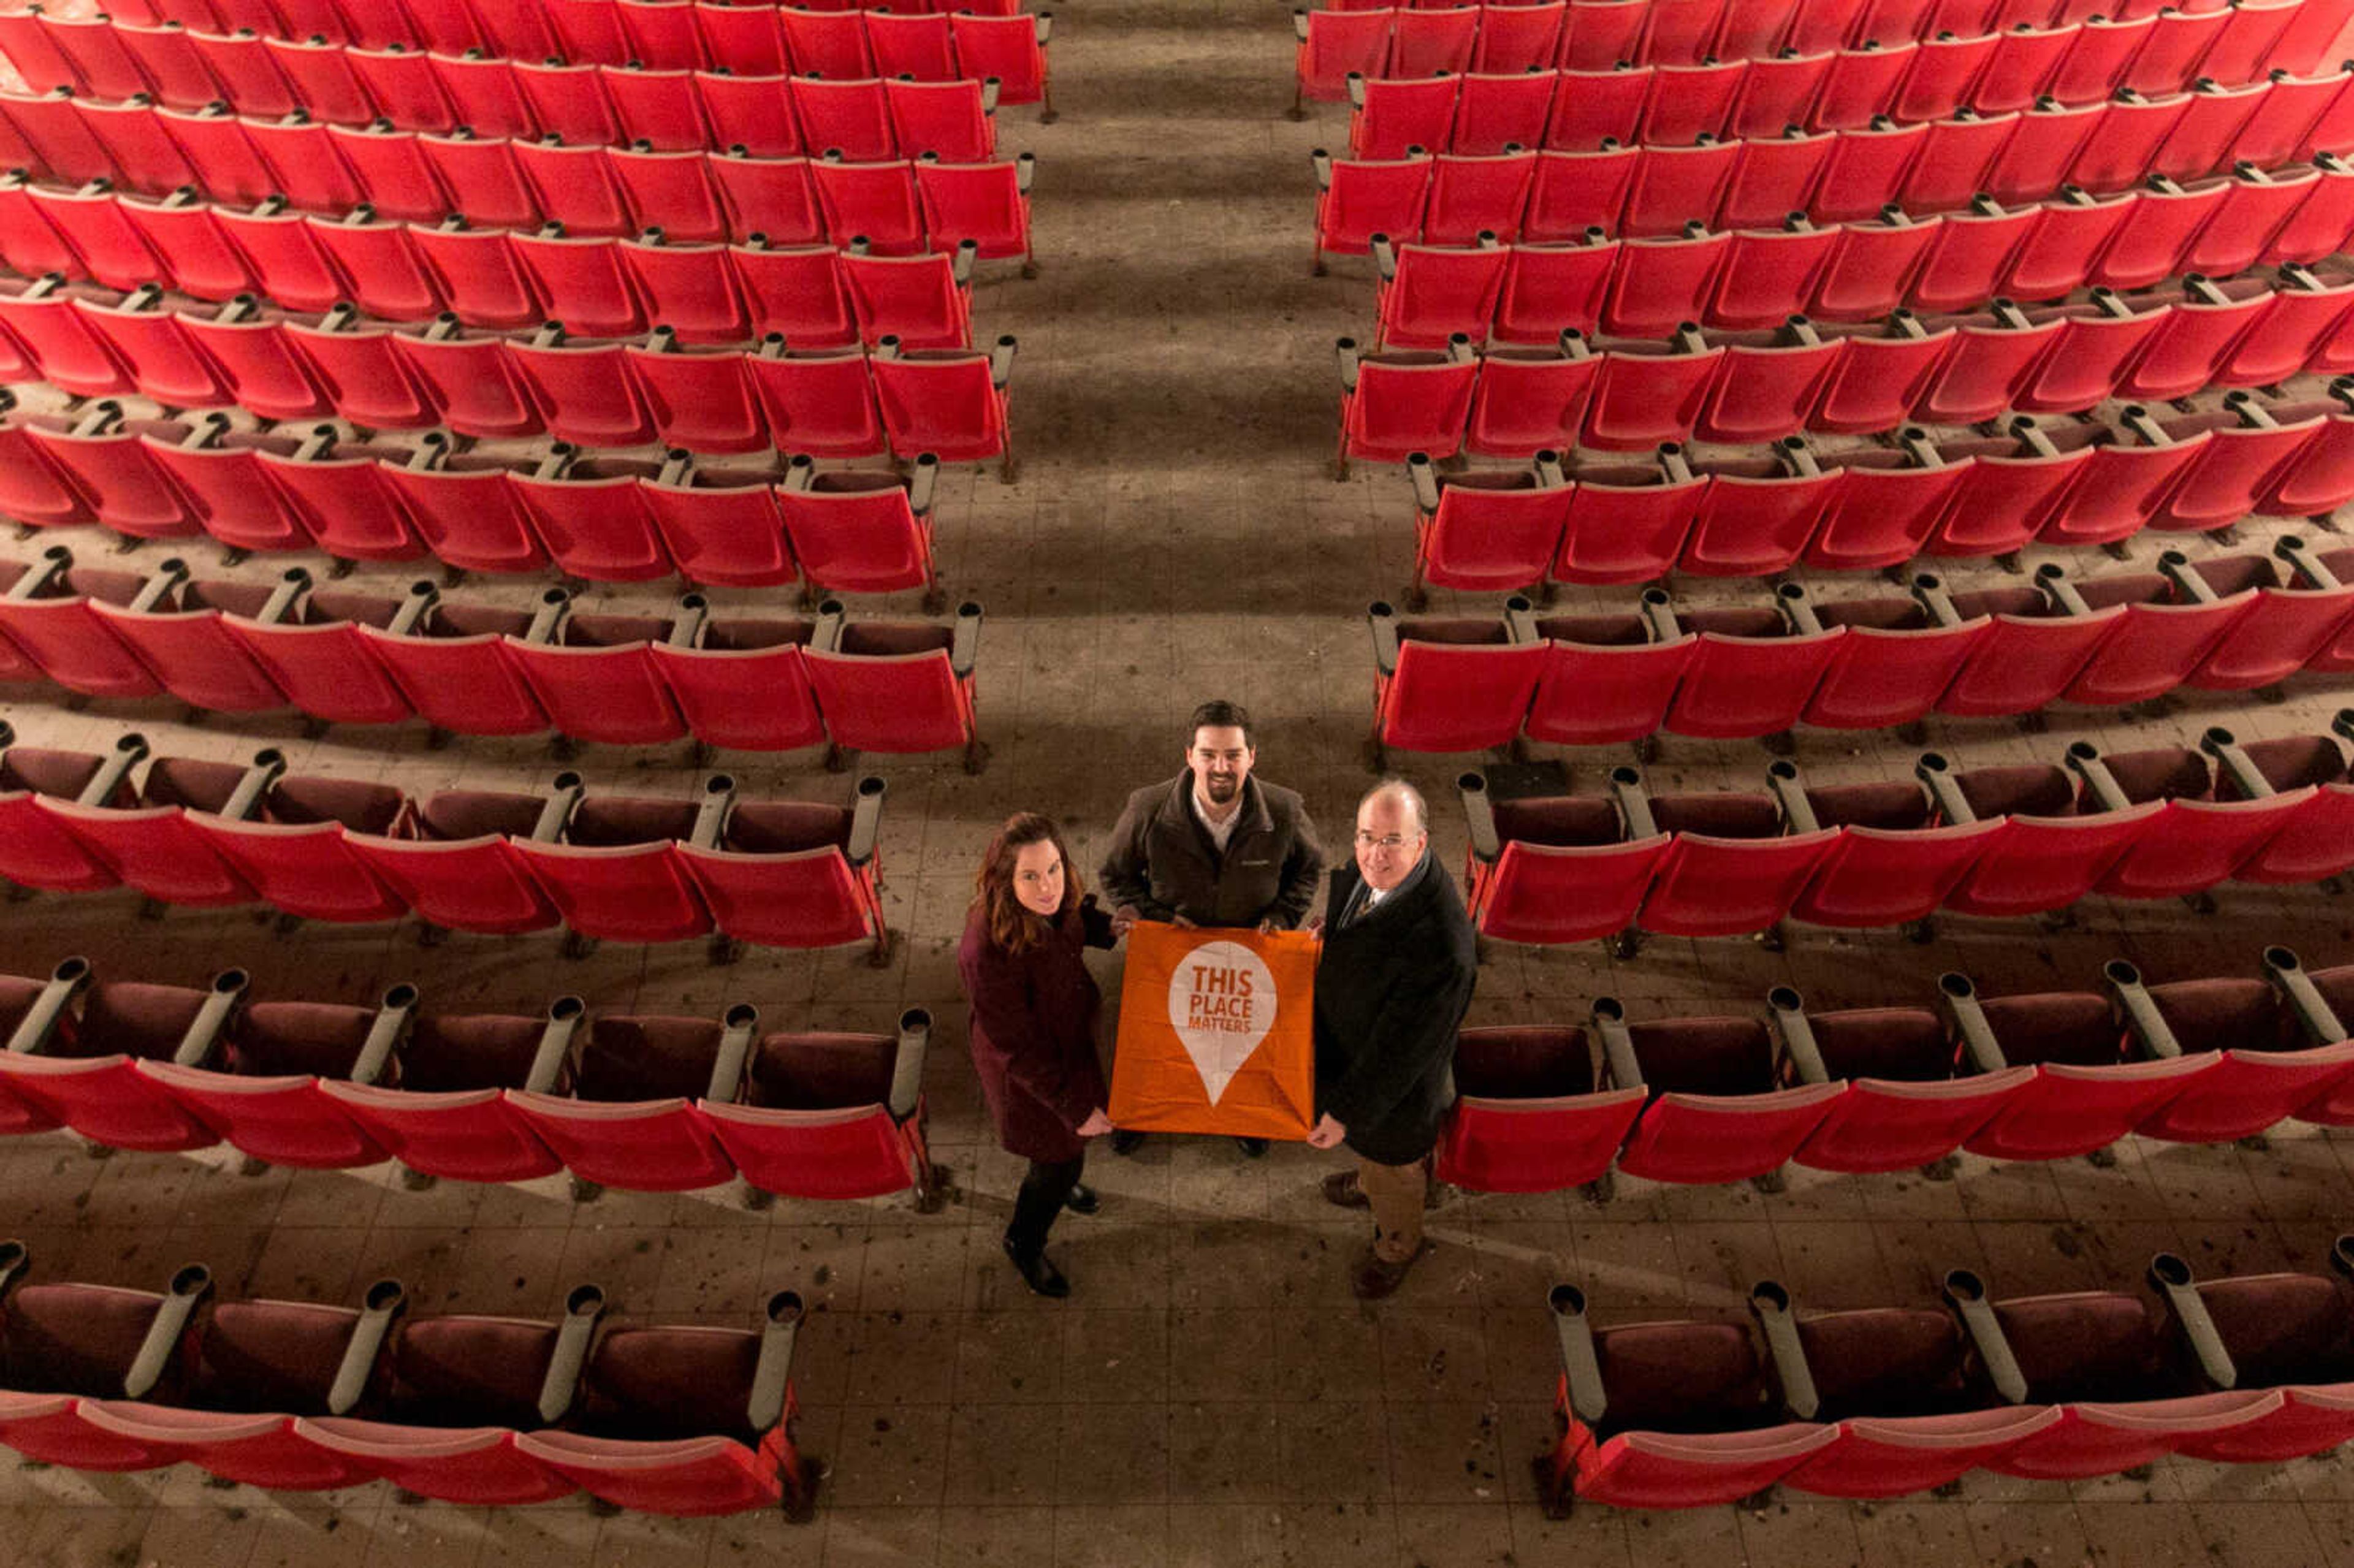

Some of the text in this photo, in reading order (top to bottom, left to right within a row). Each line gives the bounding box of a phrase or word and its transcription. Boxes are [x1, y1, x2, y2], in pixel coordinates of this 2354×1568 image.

[1193, 966, 1253, 997] THIS
[1190, 995, 1253, 1018] PLACE
[1189, 1017, 1251, 1034] MATTERS
